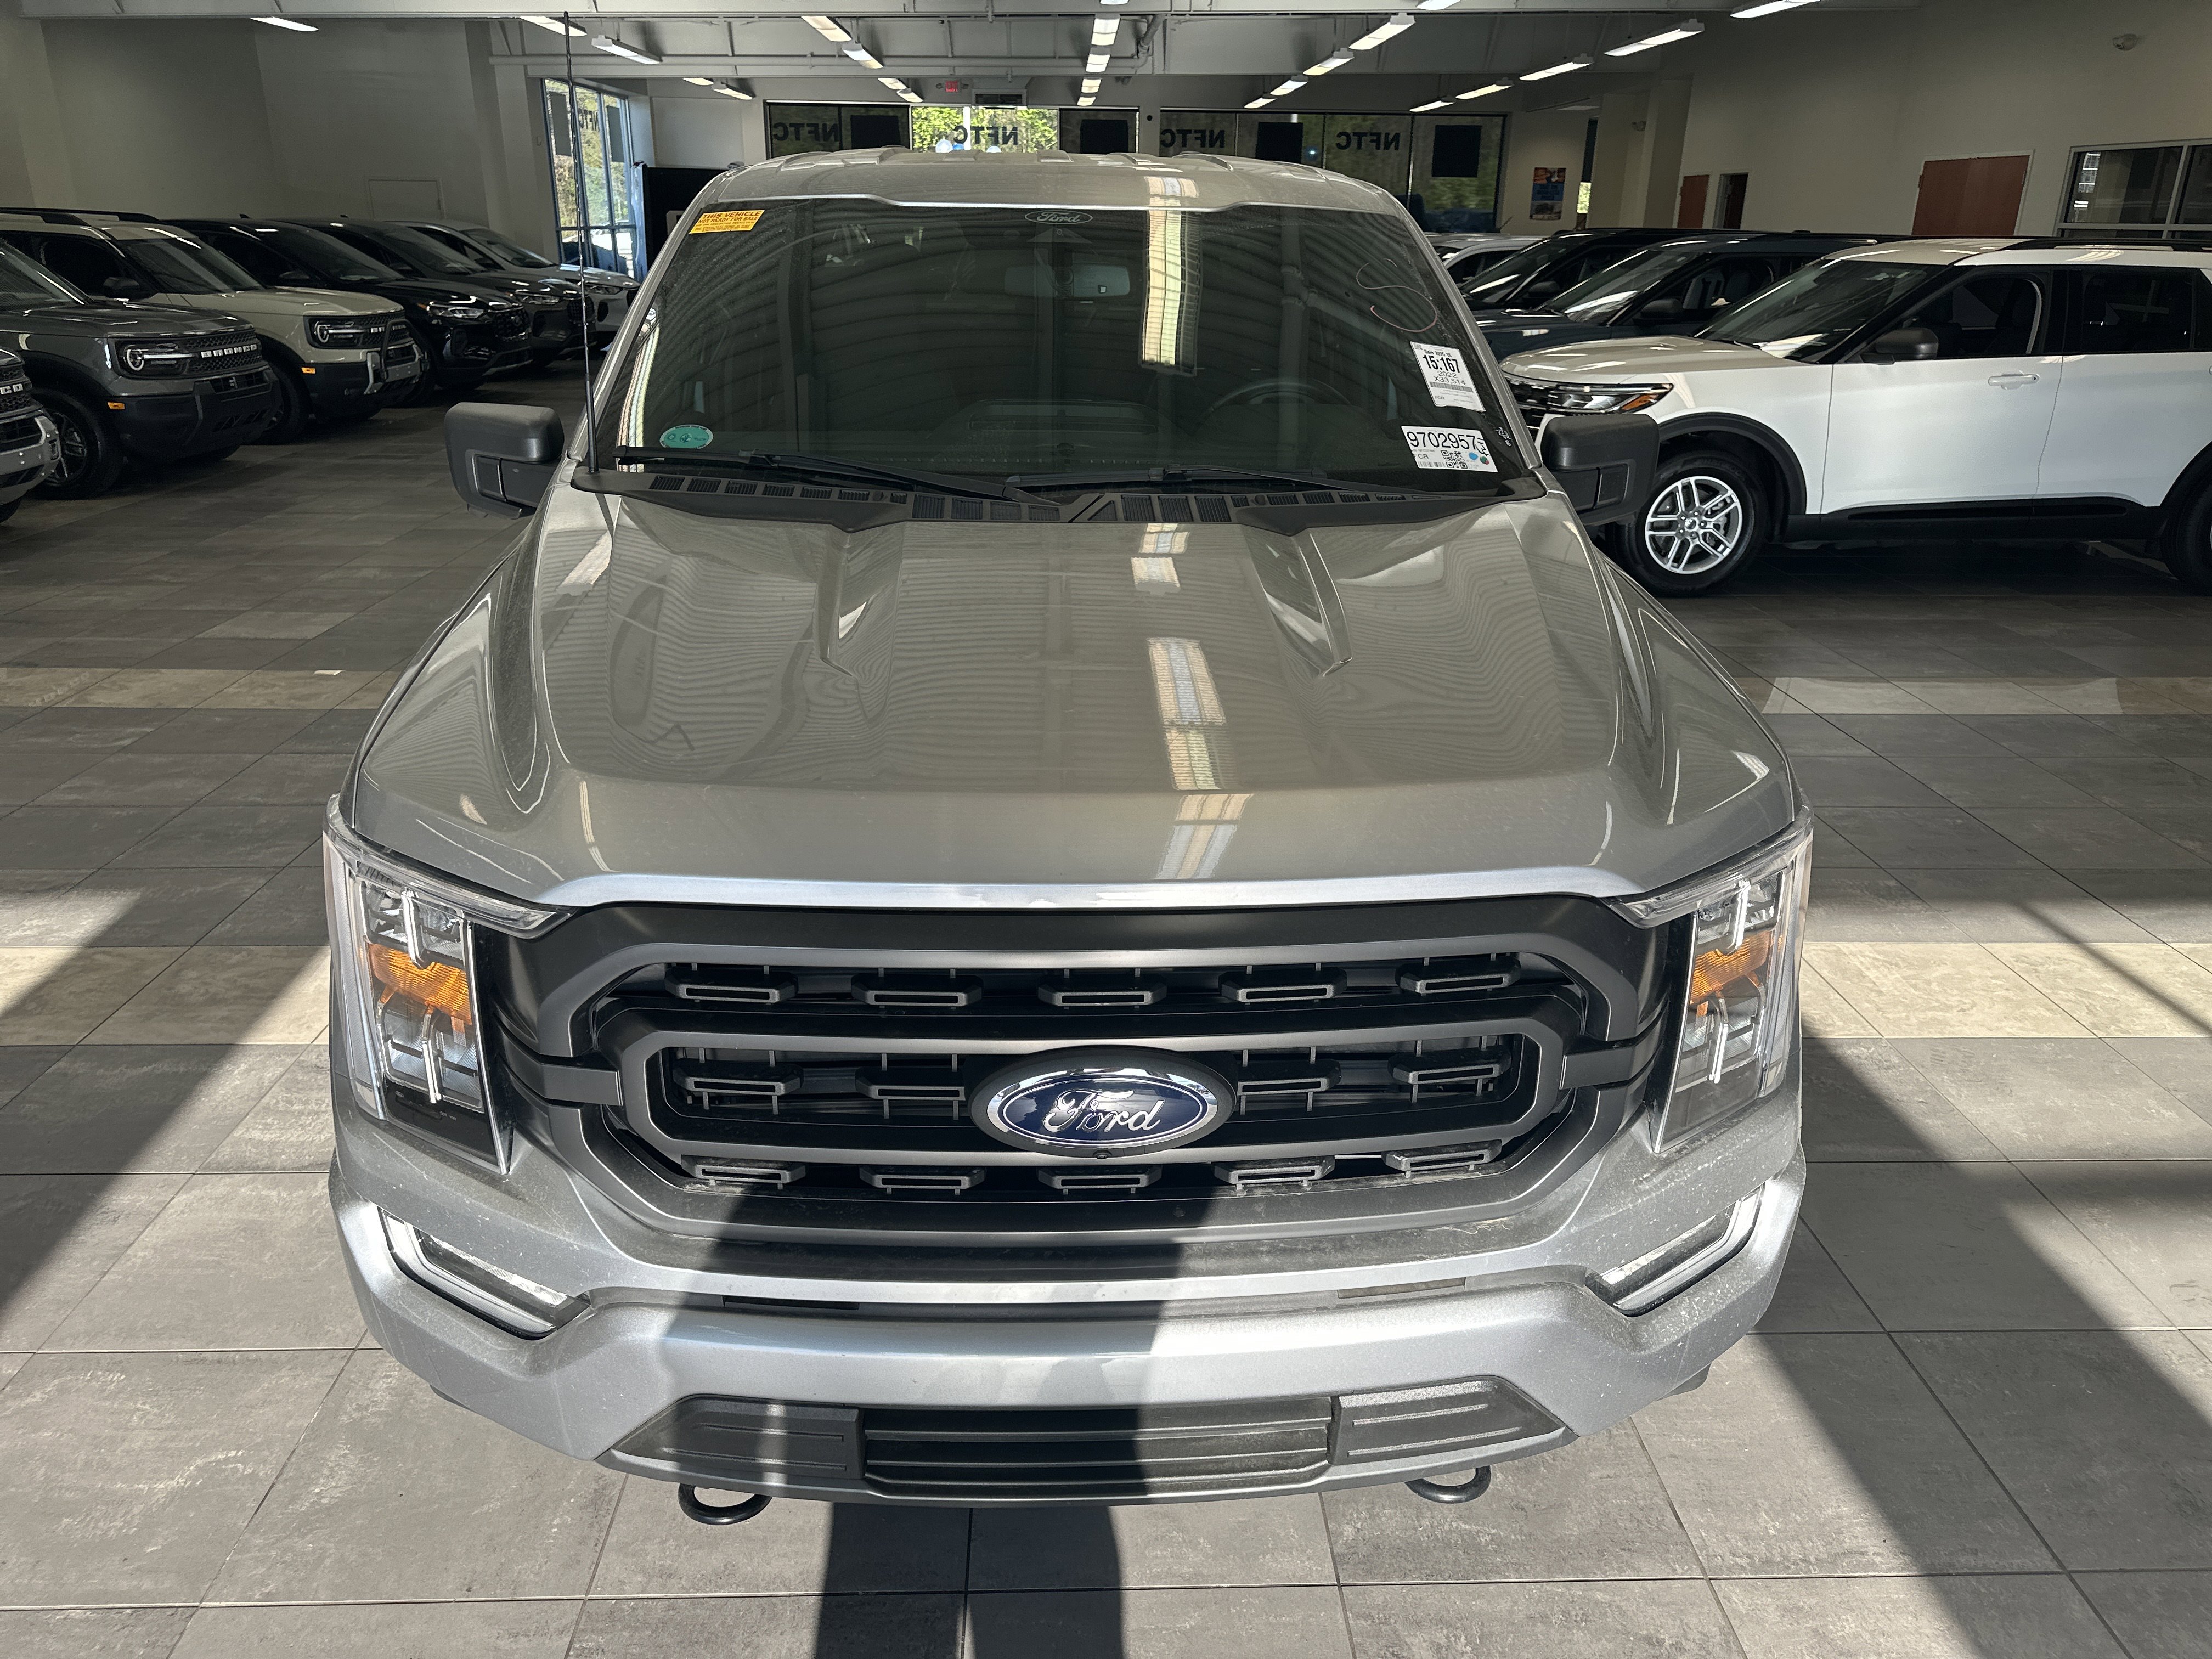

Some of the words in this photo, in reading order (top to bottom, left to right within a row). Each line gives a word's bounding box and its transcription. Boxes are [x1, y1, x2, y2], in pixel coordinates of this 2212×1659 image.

[1036, 211, 1081, 222] Ford
[1423, 354, 1460, 373] 15:167
[1407, 431, 1476, 449] 9702957
[1042, 1088, 1165, 1133] Ford
